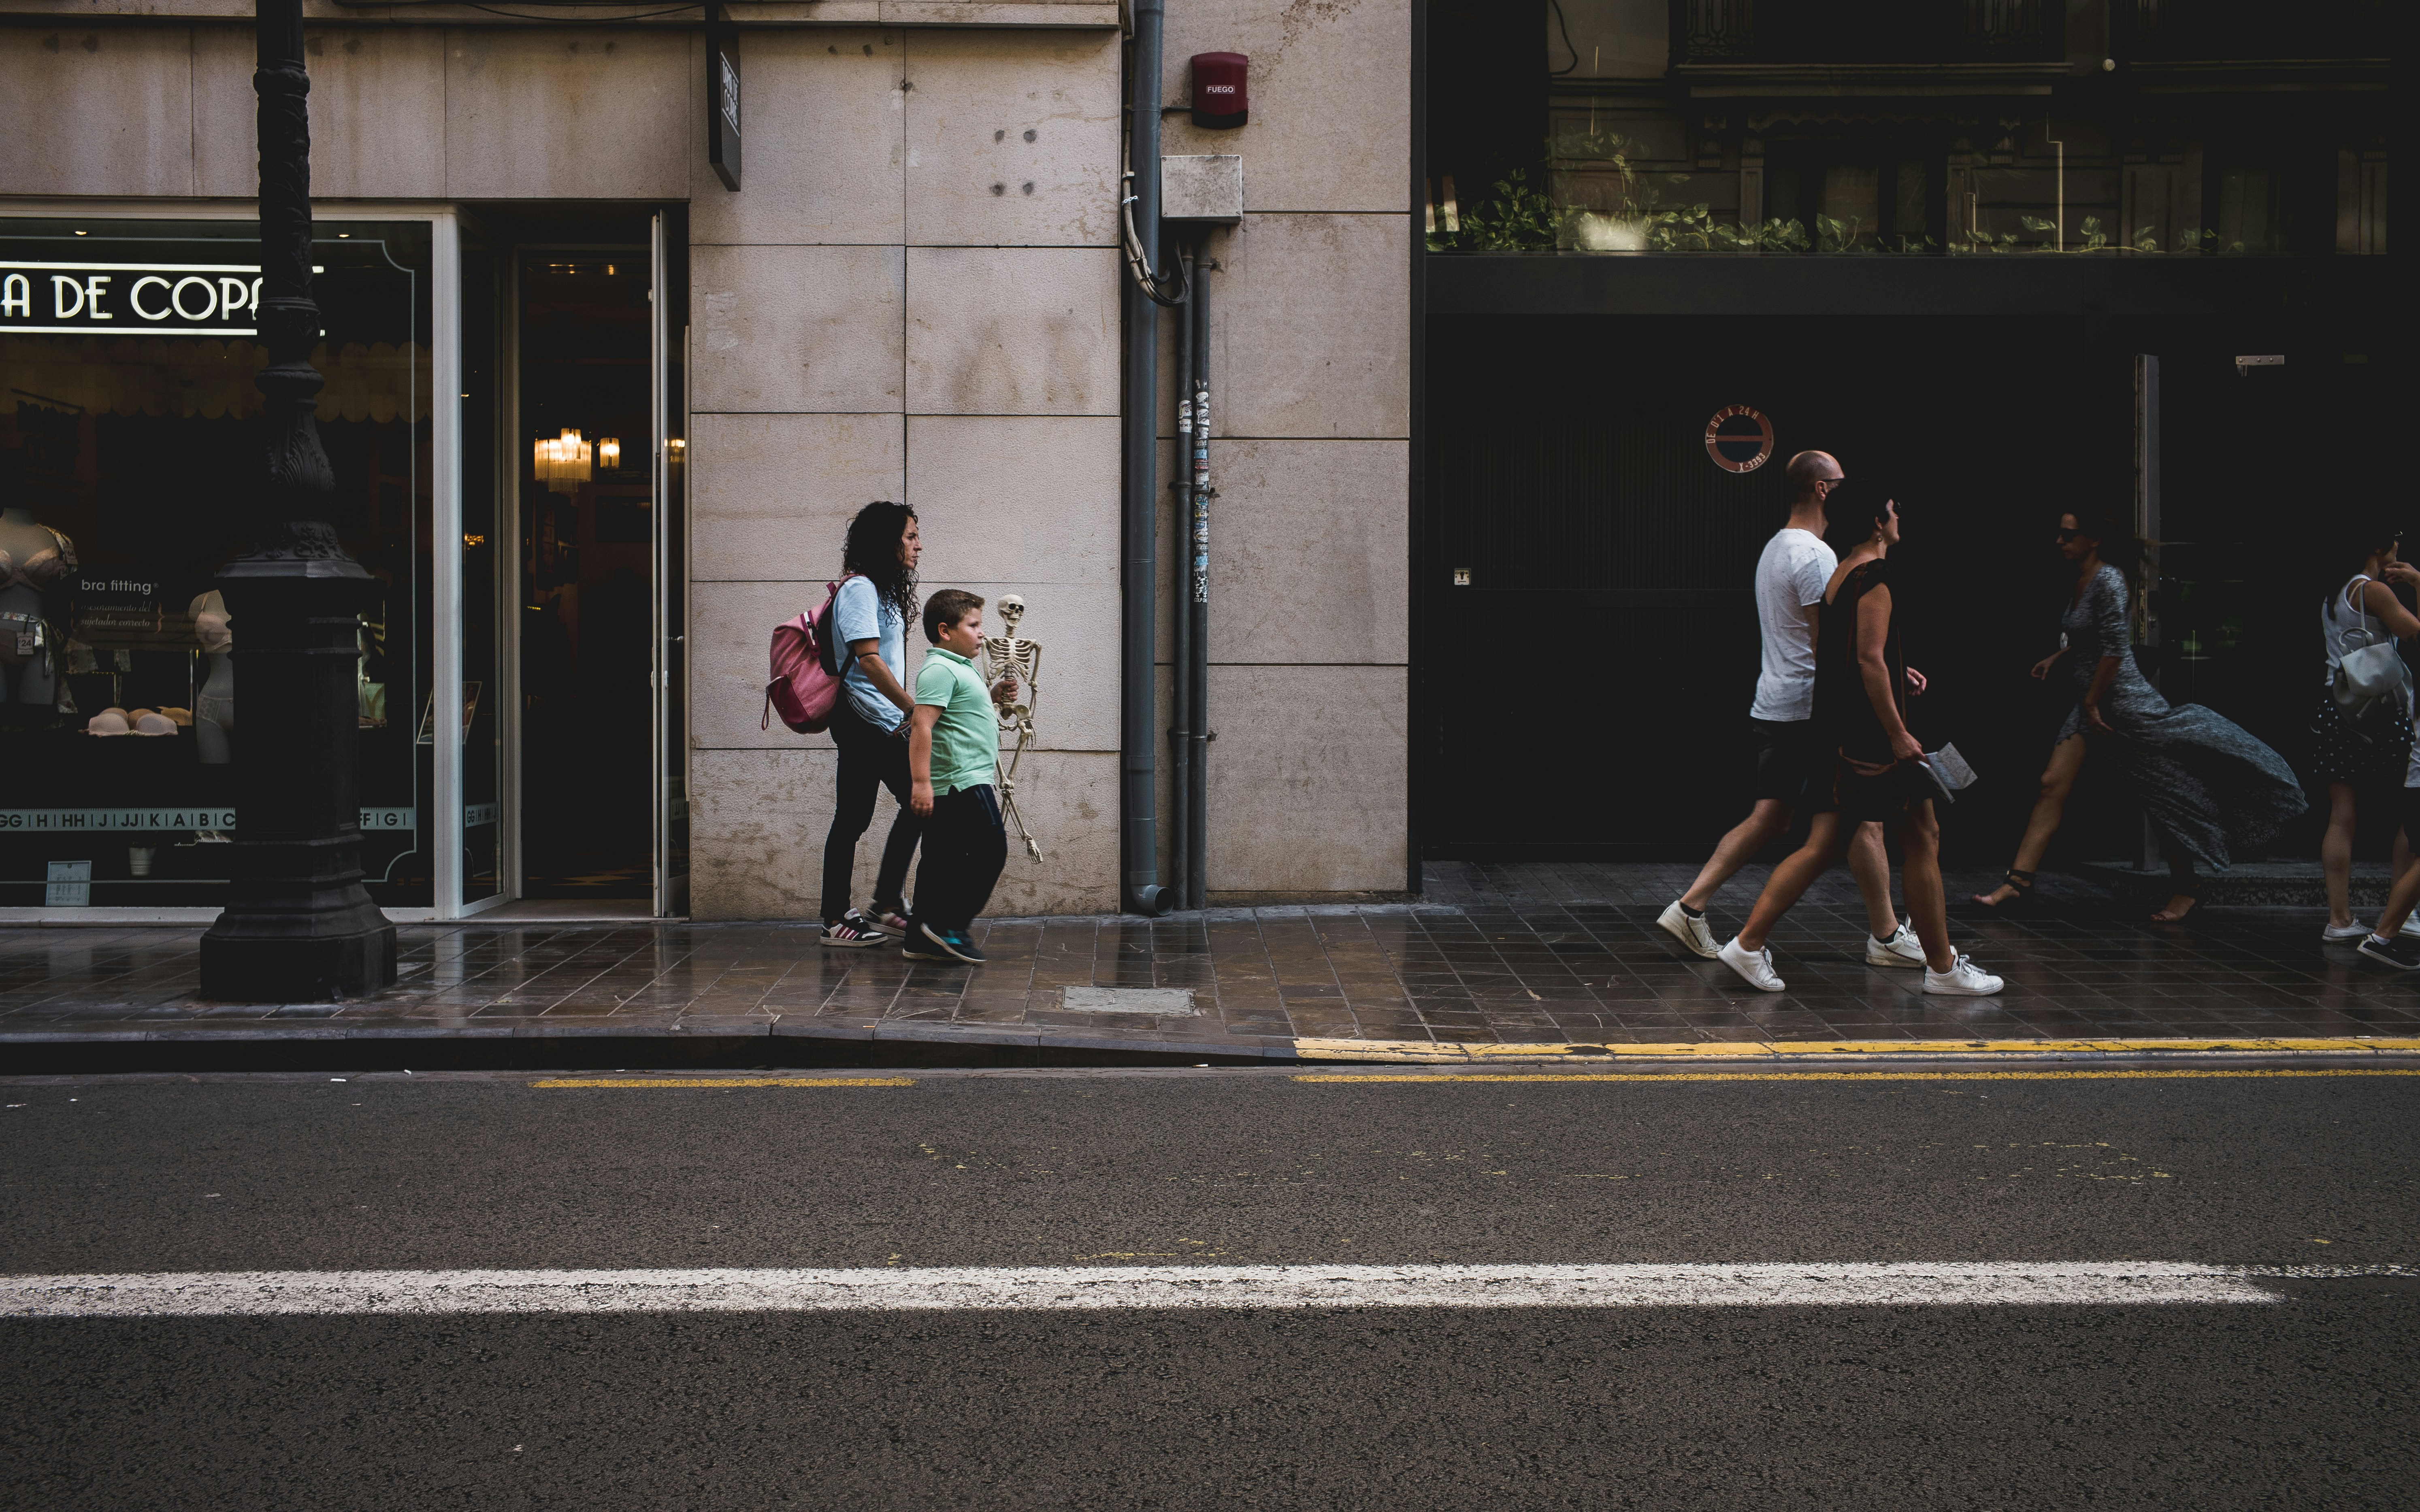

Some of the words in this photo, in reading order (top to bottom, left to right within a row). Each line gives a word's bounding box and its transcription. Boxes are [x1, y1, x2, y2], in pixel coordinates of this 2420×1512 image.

[50, 275, 113, 319] DE
[1706, 432, 1716, 444] DE
[1728, 407, 1733, 417] A
[1739, 406, 1750, 416] 24
[1751, 410, 1760, 420] H
[81, 579, 106, 591] bra
[81, 604, 137, 612] asesoramiento
[139, 600, 151, 612] del
[81, 613, 117, 628] sujetador
[119, 619, 150, 627] correcto
[0, 814, 23, 828] GG
[37, 814, 48, 827] H
[62, 814, 85, 827] HH
[98, 813, 107, 827] J
[121, 813, 138, 827] JJ
[150, 813, 160, 827] K
[173, 813, 185, 827] A
[199, 813, 209, 827] B
[222, 813, 235, 827] C
[360, 812, 371, 826] F
[384, 812, 398, 826] G
[467, 810, 475, 823] GG
[478, 809, 481, 822] H
[484, 808, 491, 821] HH
